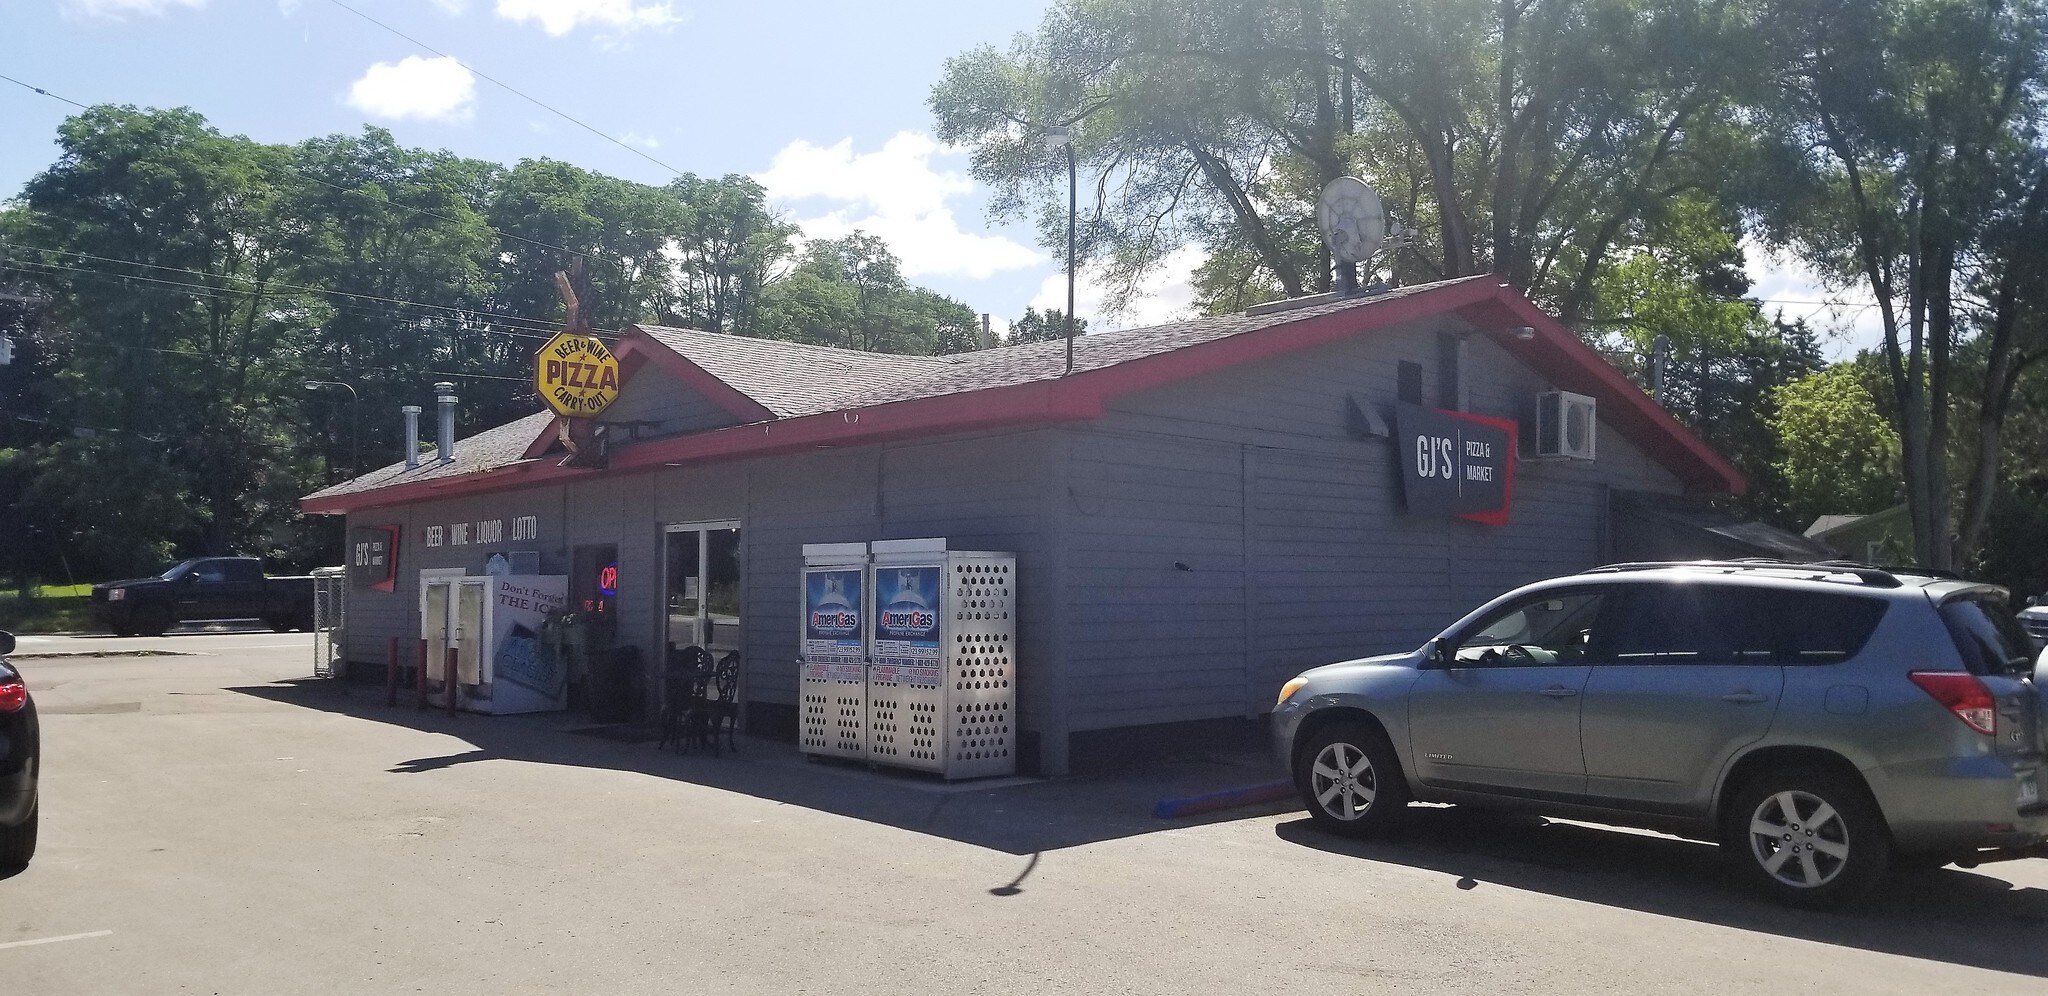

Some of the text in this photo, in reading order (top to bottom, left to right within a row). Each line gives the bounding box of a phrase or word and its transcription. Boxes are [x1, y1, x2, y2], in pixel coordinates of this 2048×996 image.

[554, 338, 581, 359] BEER
[586, 339, 611, 364] WINE
[546, 359, 618, 391] PIZZA
[1416, 434, 1453, 480] GJ'S
[1466, 440, 1490, 458] PIZZA &
[1466, 464, 1493, 482] MARKET
[426, 515, 537, 547] BEER WINE LIQUOR LOTTO
[501, 582, 529, 596] Don't
[499, 594, 529, 610] THE
[812, 611, 856, 628] AmeriGas
[882, 611, 933, 628] AmeriGas
